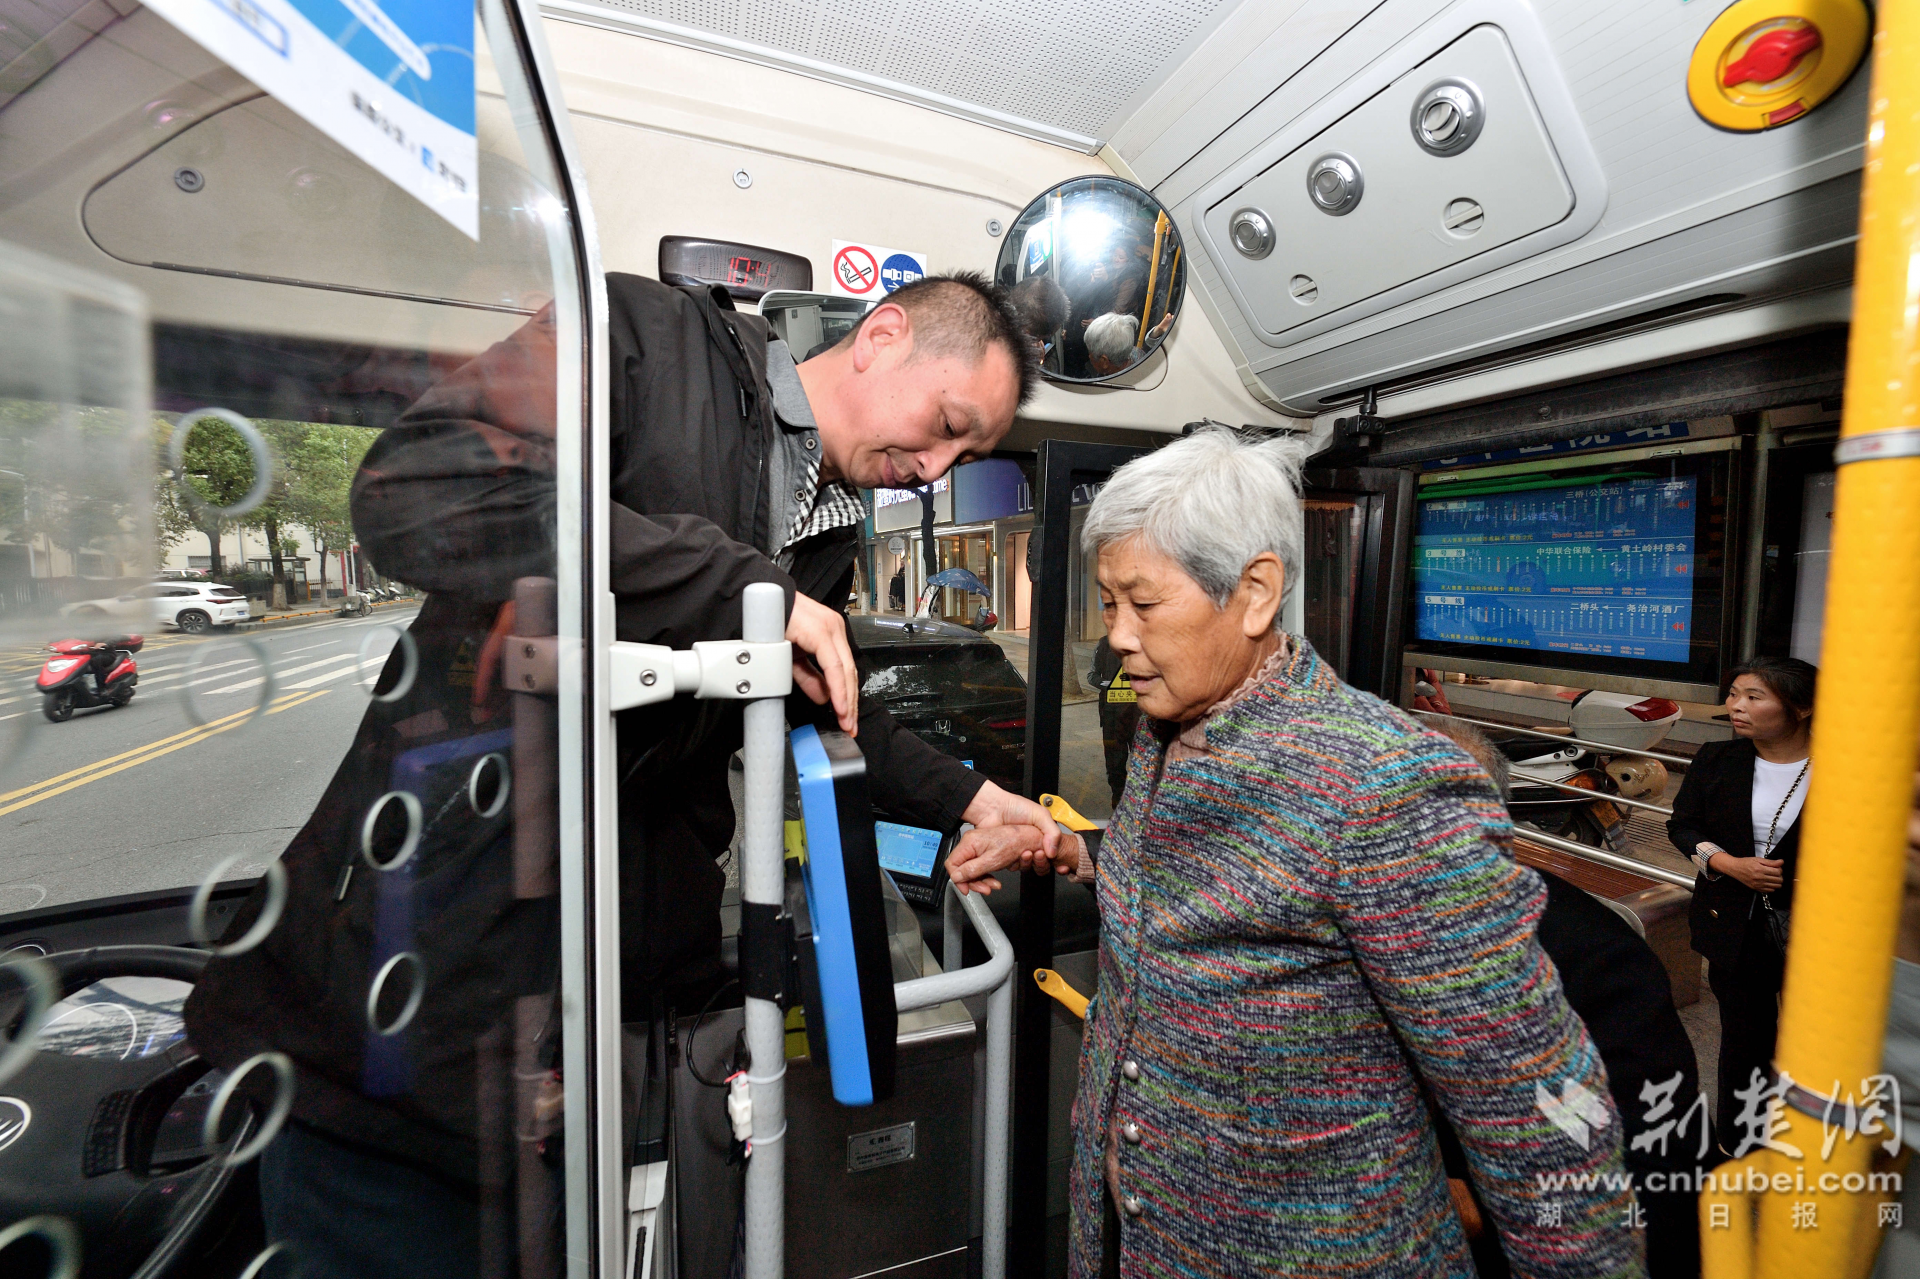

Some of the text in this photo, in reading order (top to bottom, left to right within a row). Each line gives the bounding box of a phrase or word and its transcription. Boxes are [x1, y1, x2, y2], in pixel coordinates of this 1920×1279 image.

[1536, 542, 1687, 556] 中华联合保险 黄土岭村委会
[1570, 602, 1685, 614] 二桥头 尧治河酒厂
